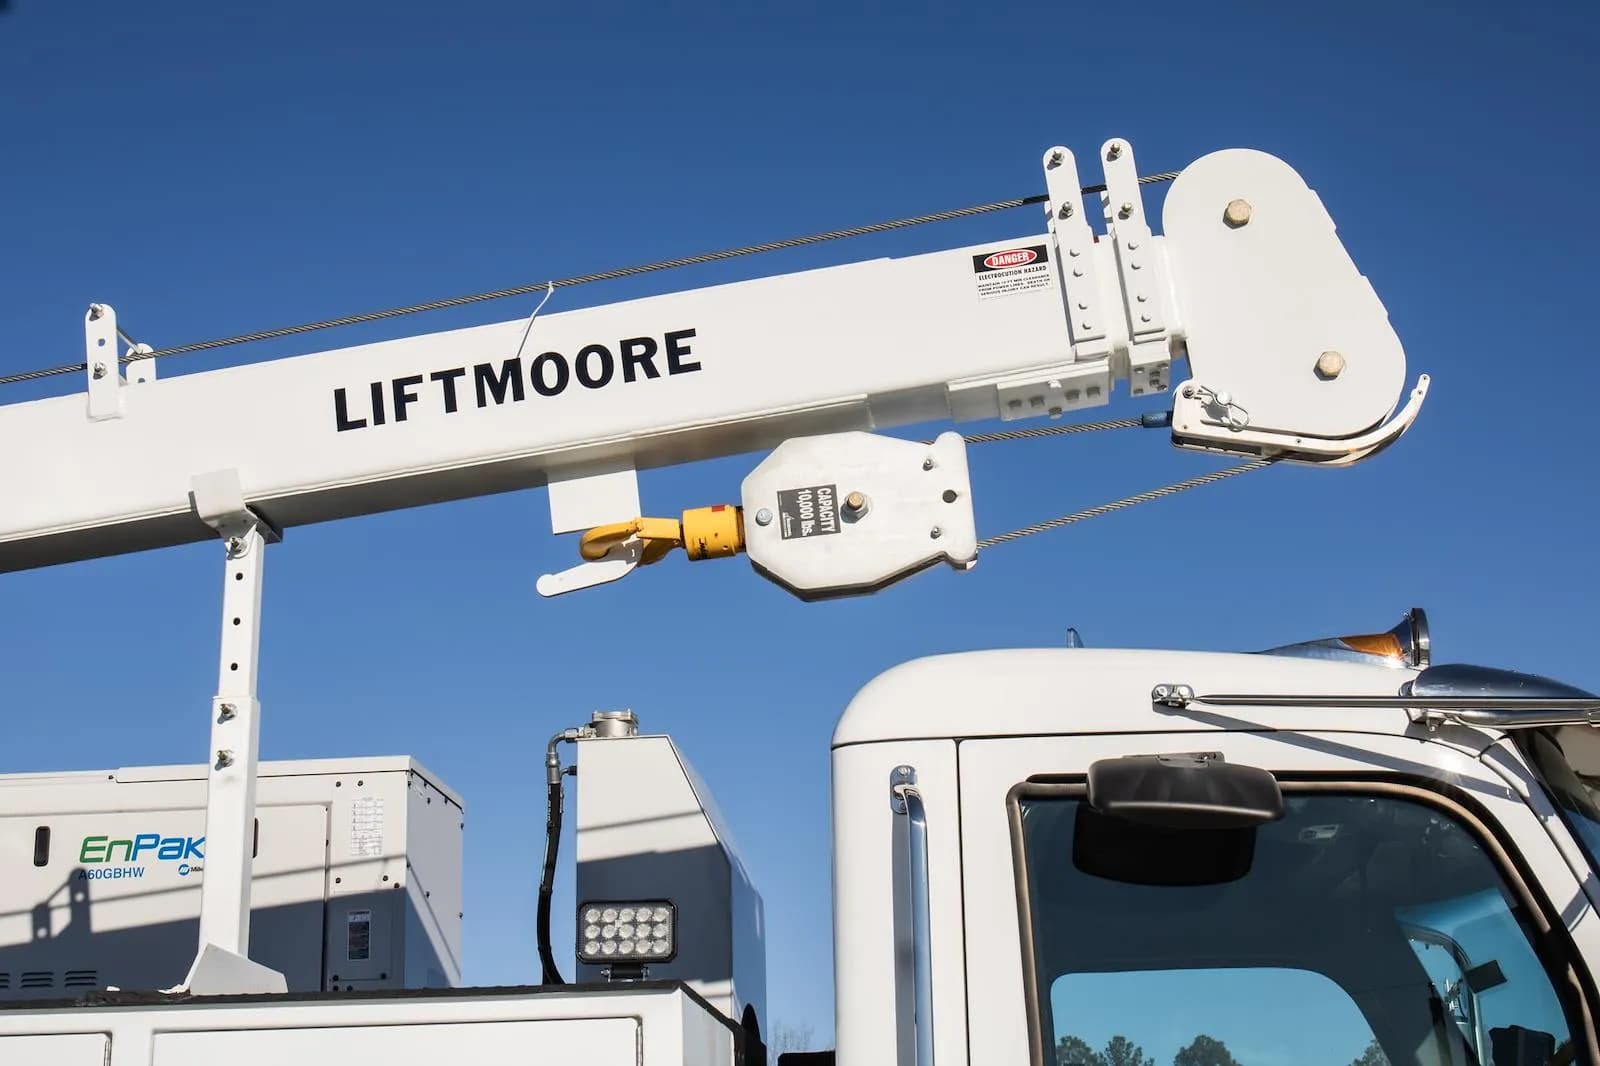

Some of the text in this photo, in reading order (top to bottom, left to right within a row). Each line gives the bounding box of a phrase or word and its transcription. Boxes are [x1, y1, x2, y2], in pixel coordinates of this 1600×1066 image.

[992, 252, 1029, 266] DANGER
[979, 269, 1022, 280] ELECTROCUTION
[334, 328, 702, 432] LIFTMOORE
[796, 489, 814, 519] 10,000
[817, 488, 836, 532] CAPACITY
[80, 834, 206, 863] EnPak
[79, 867, 144, 880] A60GBHW
